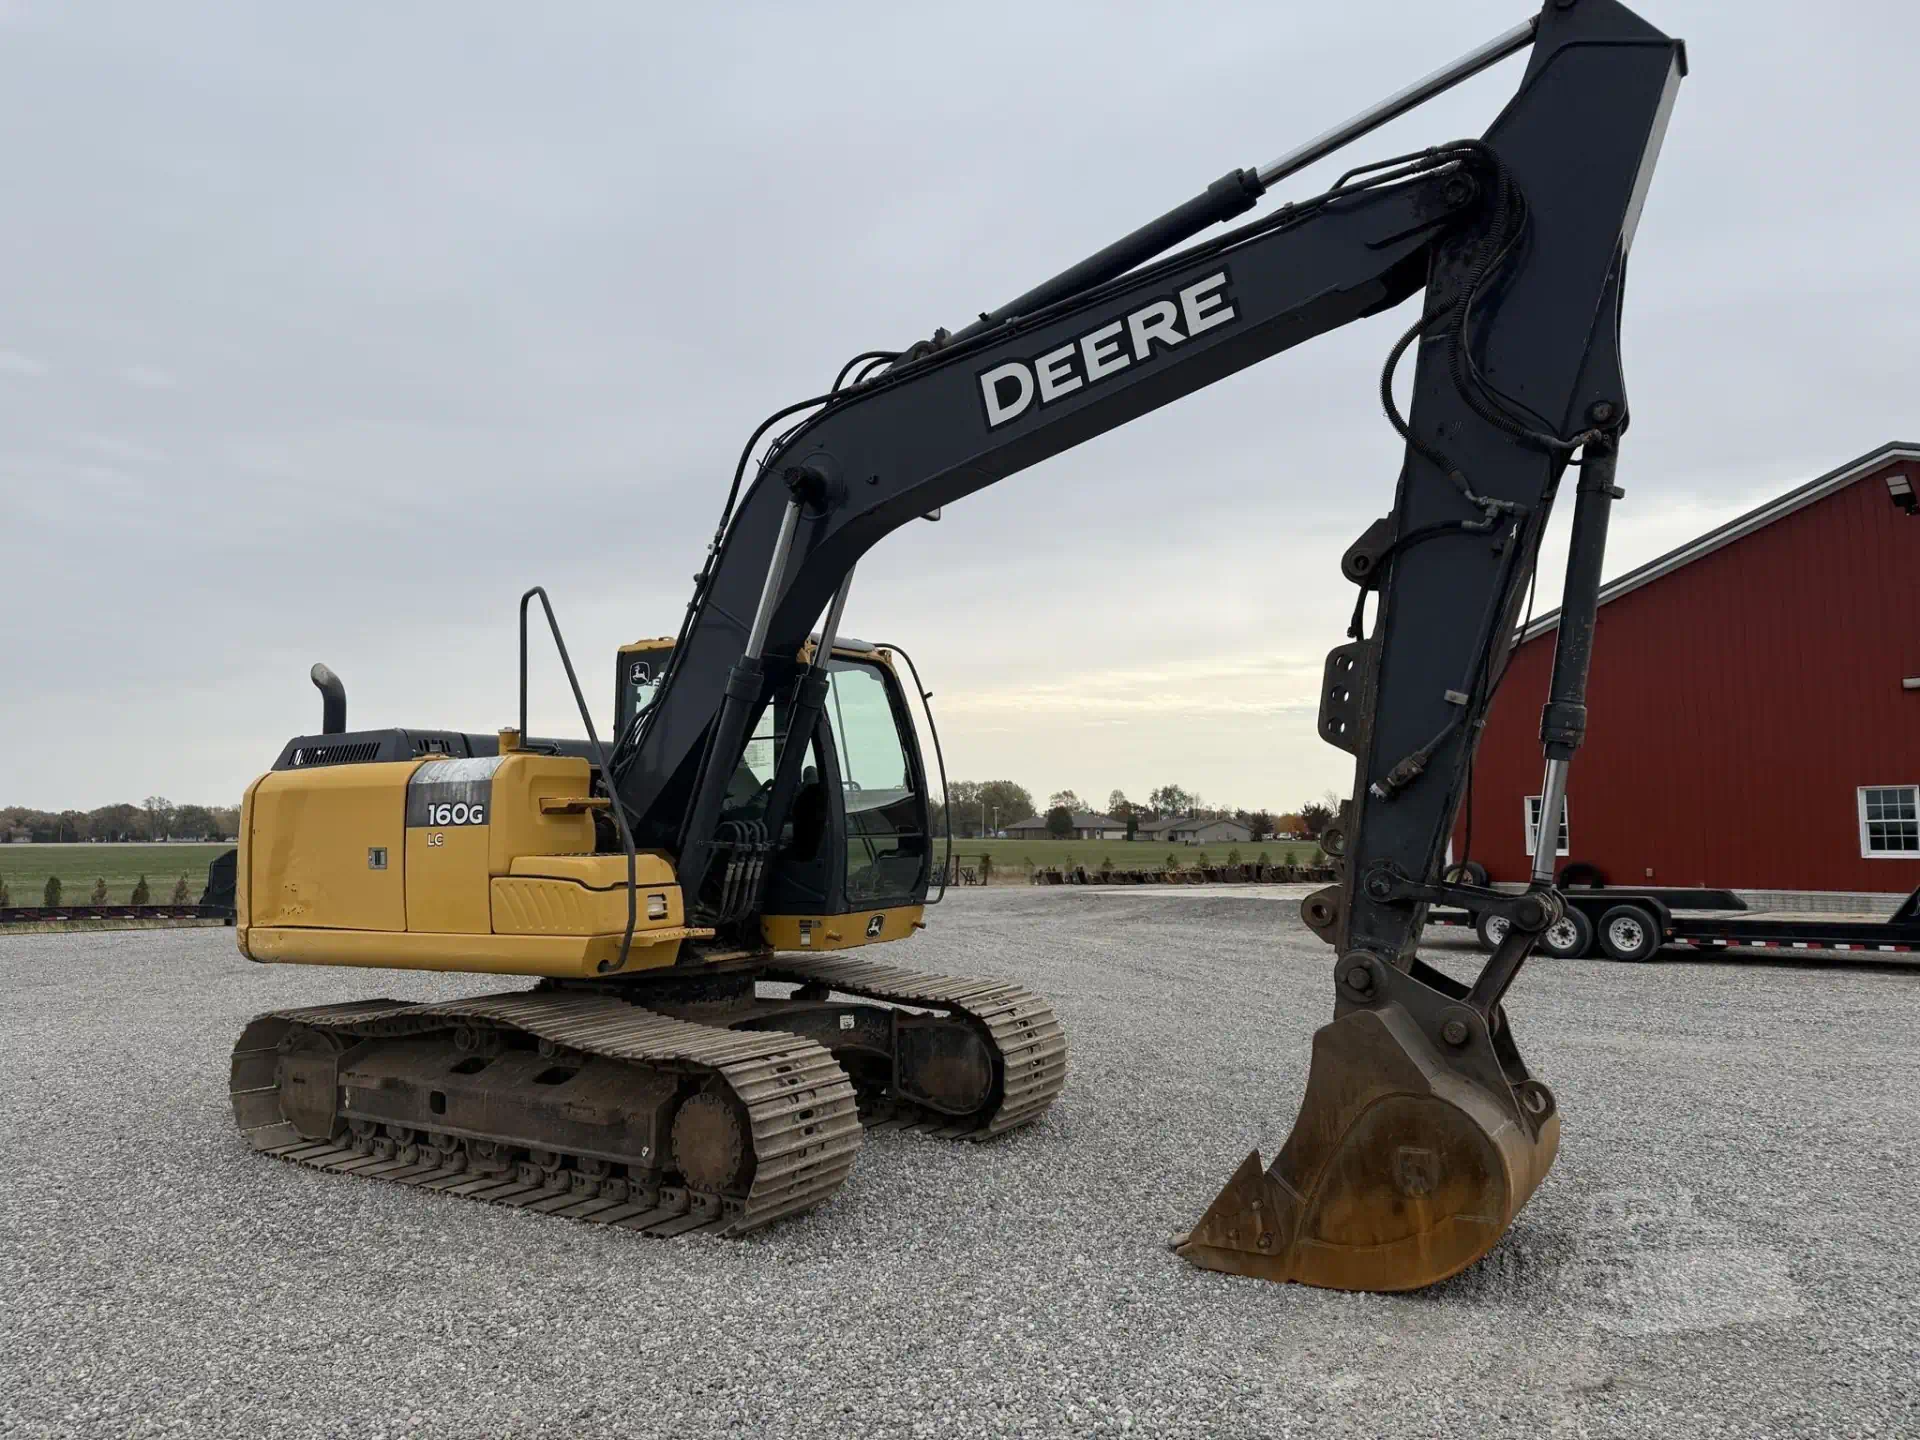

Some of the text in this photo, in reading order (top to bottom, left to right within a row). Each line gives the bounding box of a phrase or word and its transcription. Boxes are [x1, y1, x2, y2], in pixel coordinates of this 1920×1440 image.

[980, 271, 1235, 427] DEERE
[428, 803, 483, 825] 160G
[427, 833, 444, 846] LC
